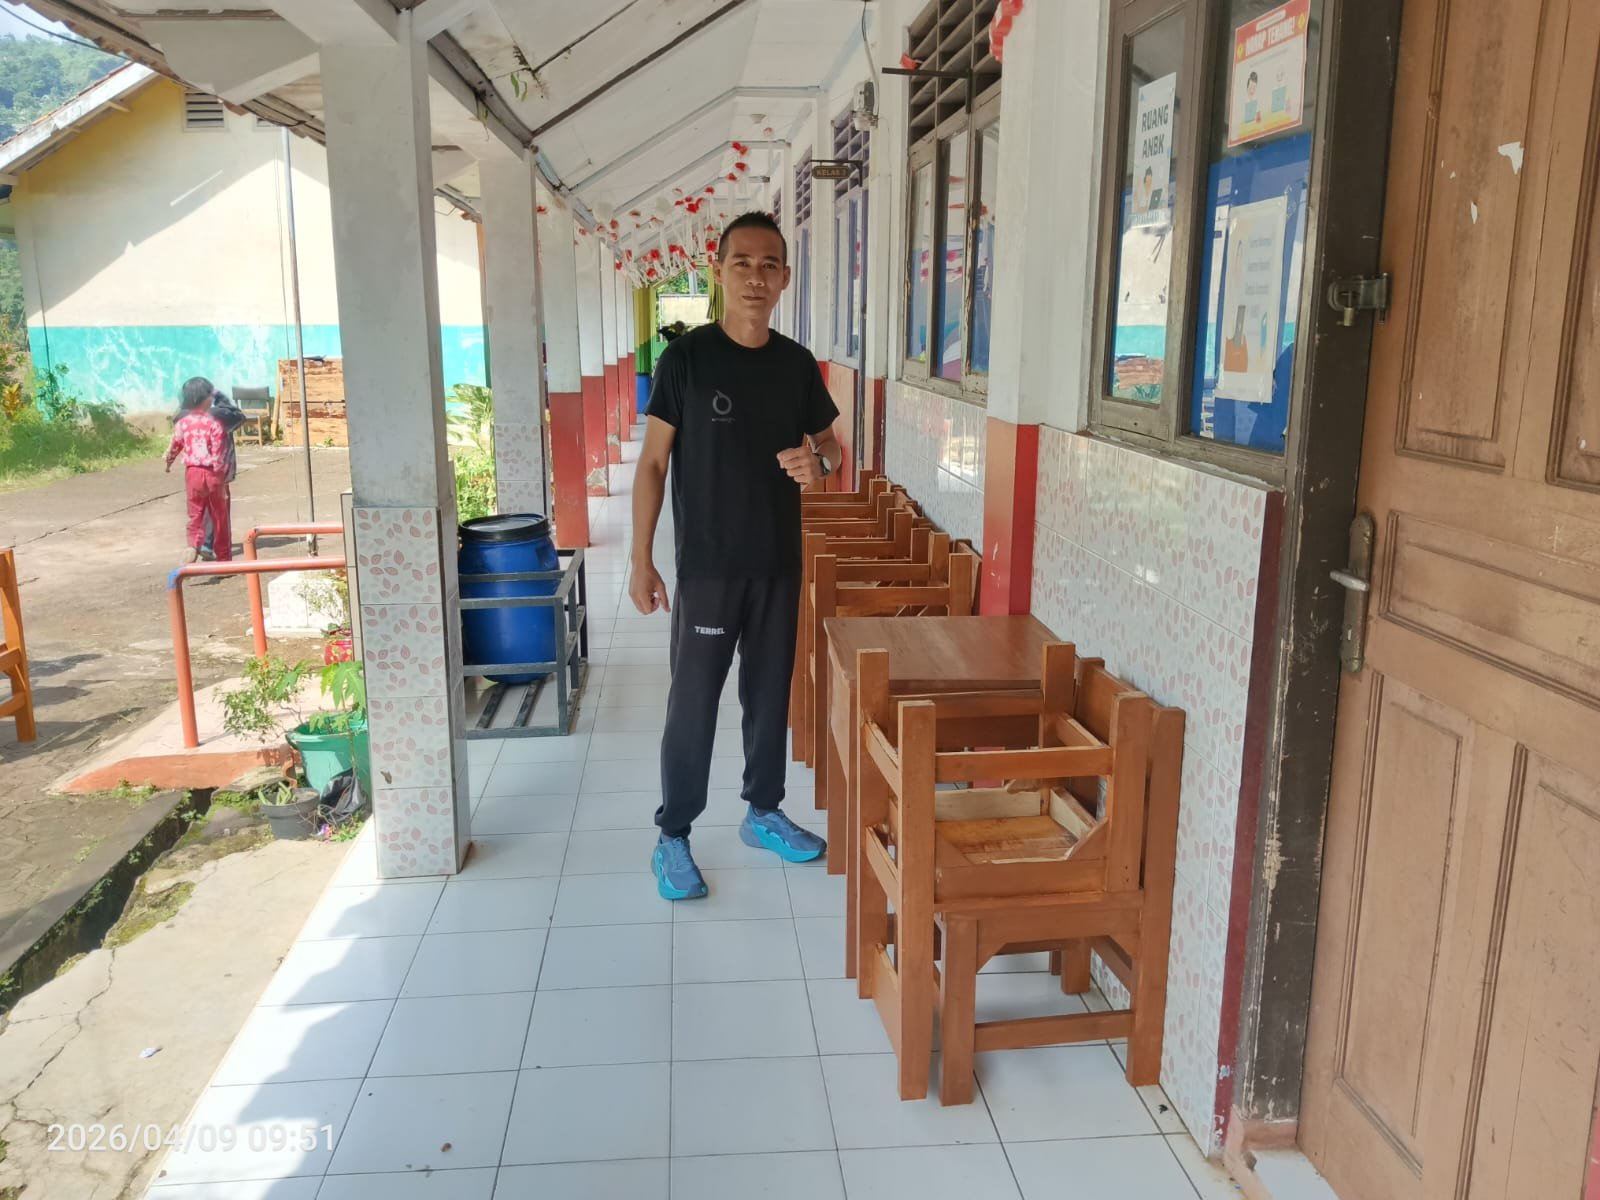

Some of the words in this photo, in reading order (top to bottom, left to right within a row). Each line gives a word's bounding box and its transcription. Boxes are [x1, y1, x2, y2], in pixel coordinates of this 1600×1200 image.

[1141, 103, 1169, 133] RUANG
[1142, 133, 1165, 159] ANBK
[816, 169, 842, 177] KELAS
[694, 625, 725, 635] TERREL
